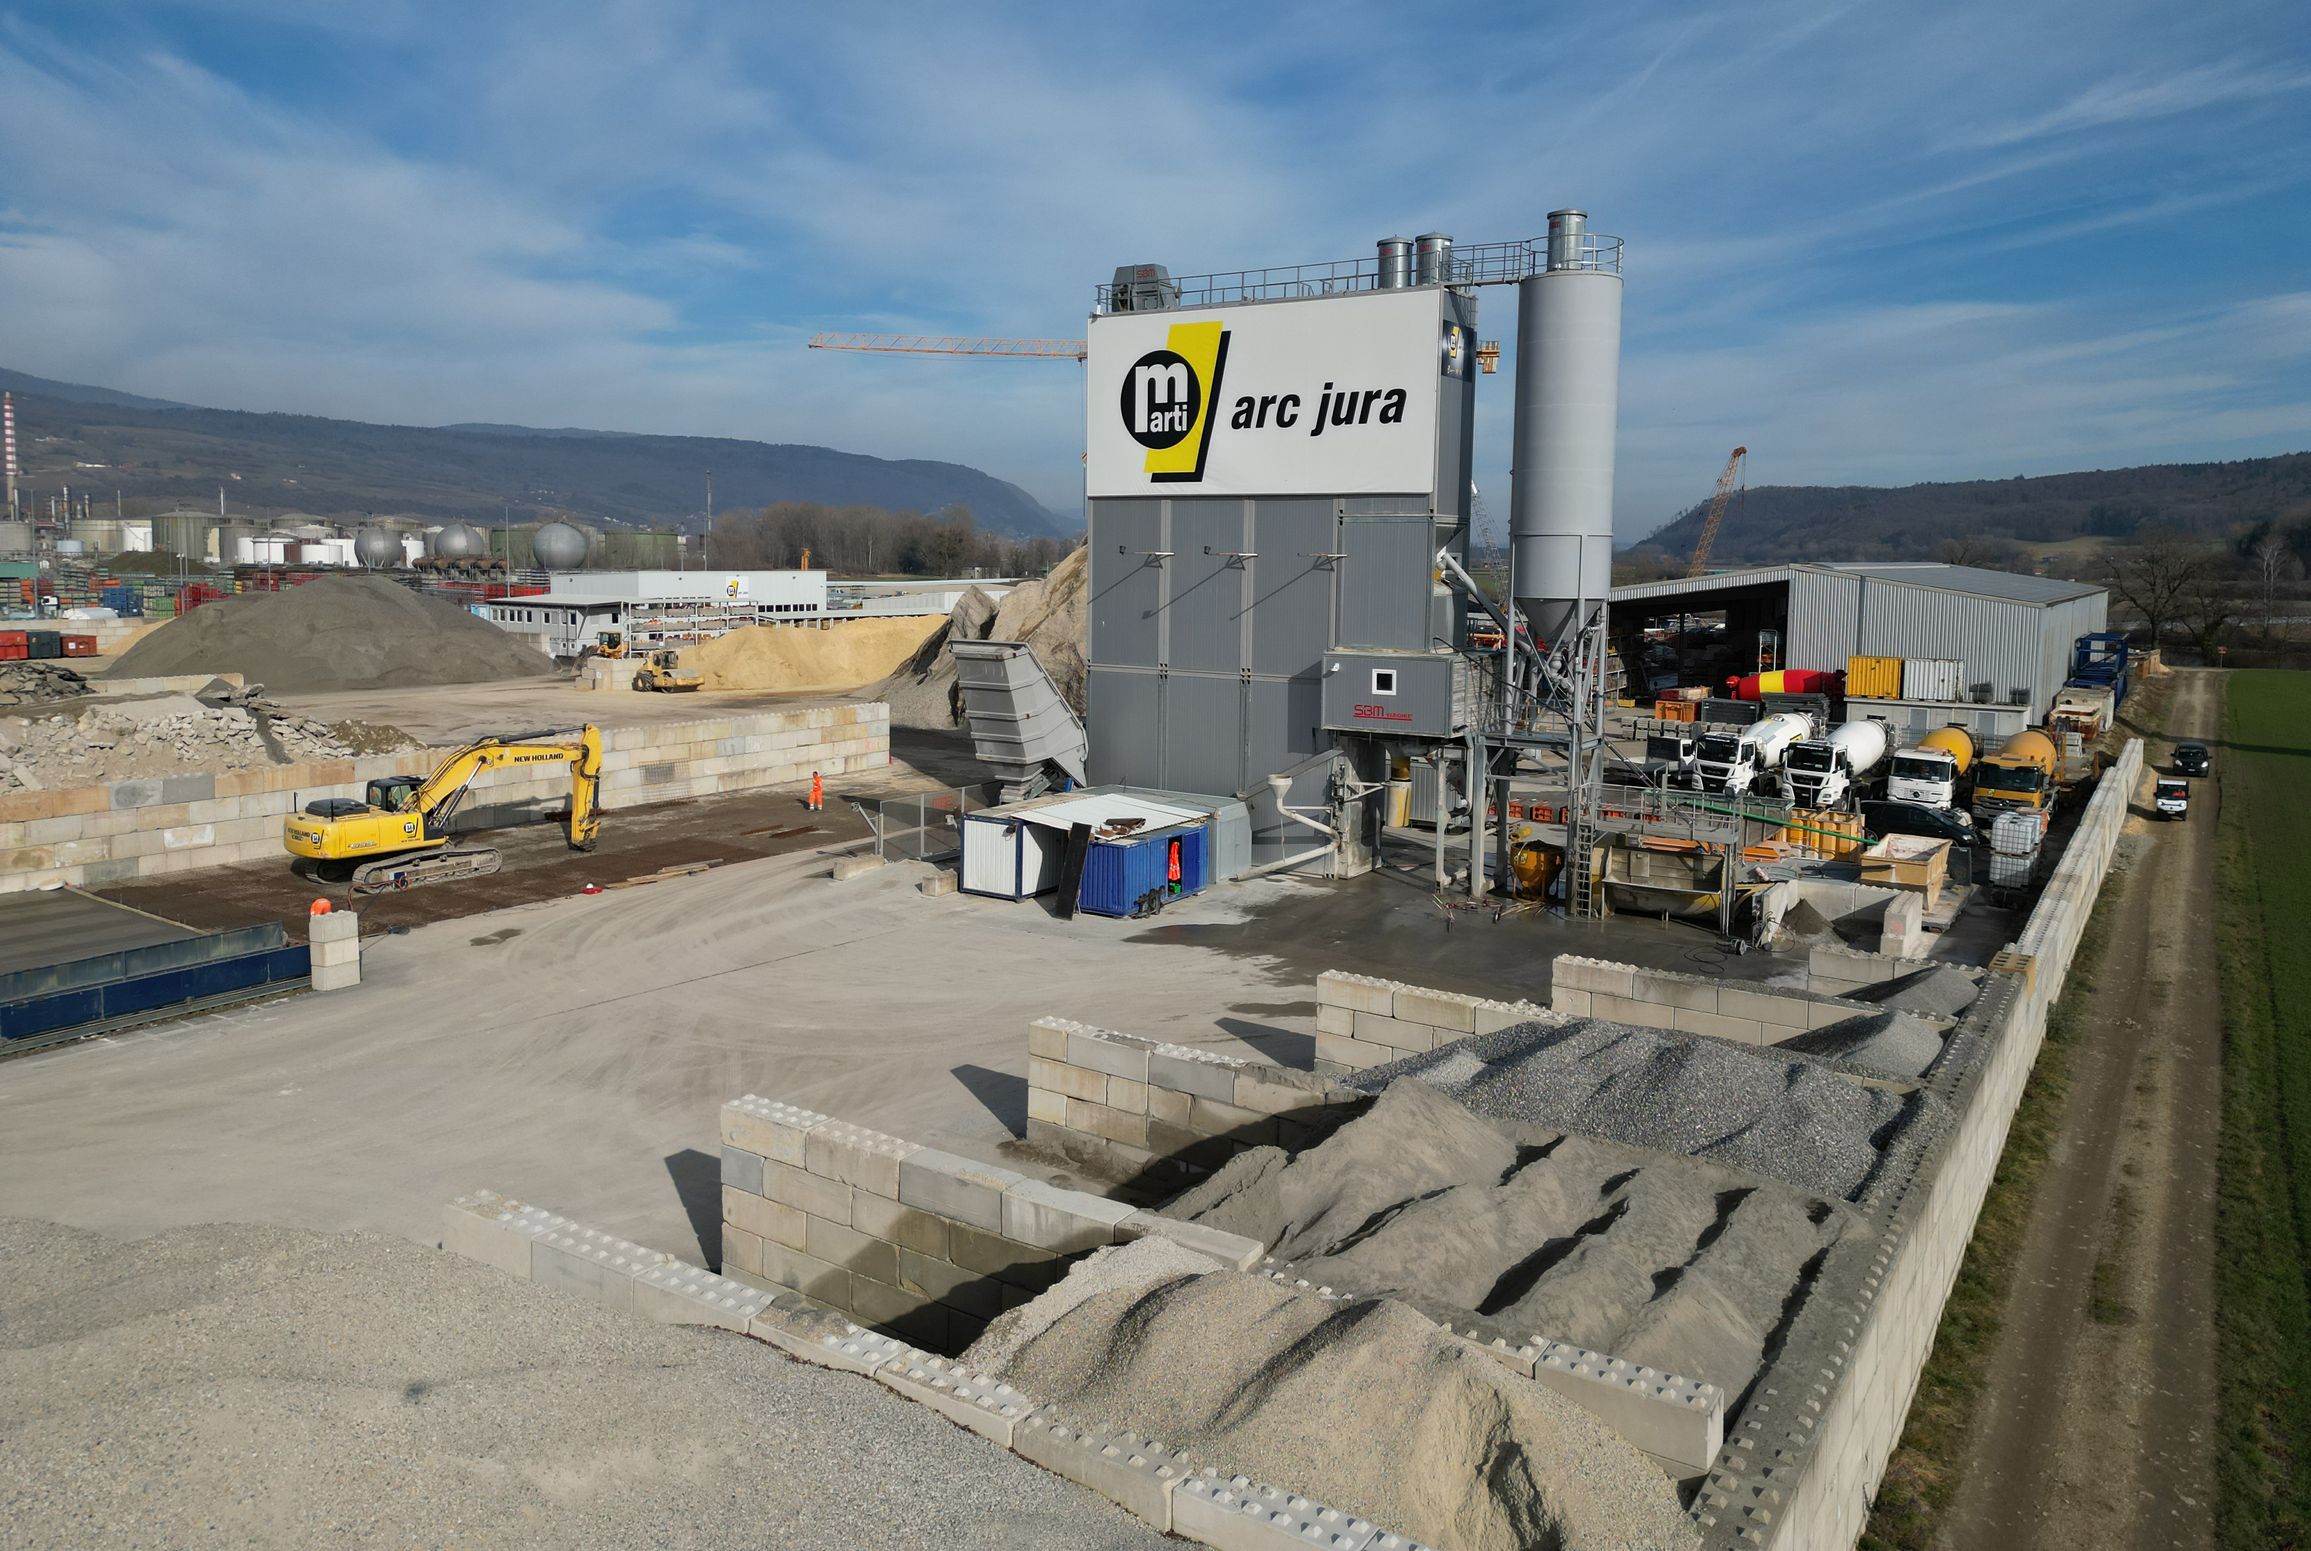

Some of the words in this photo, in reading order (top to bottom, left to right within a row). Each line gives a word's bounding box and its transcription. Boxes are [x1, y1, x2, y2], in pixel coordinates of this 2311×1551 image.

[1231, 393, 1300, 430] arc
[1310, 381, 1407, 437] jura
[1354, 704, 1385, 717] SBM
[514, 755, 531, 763] NEW
[531, 753, 563, 761] HOLLAND
